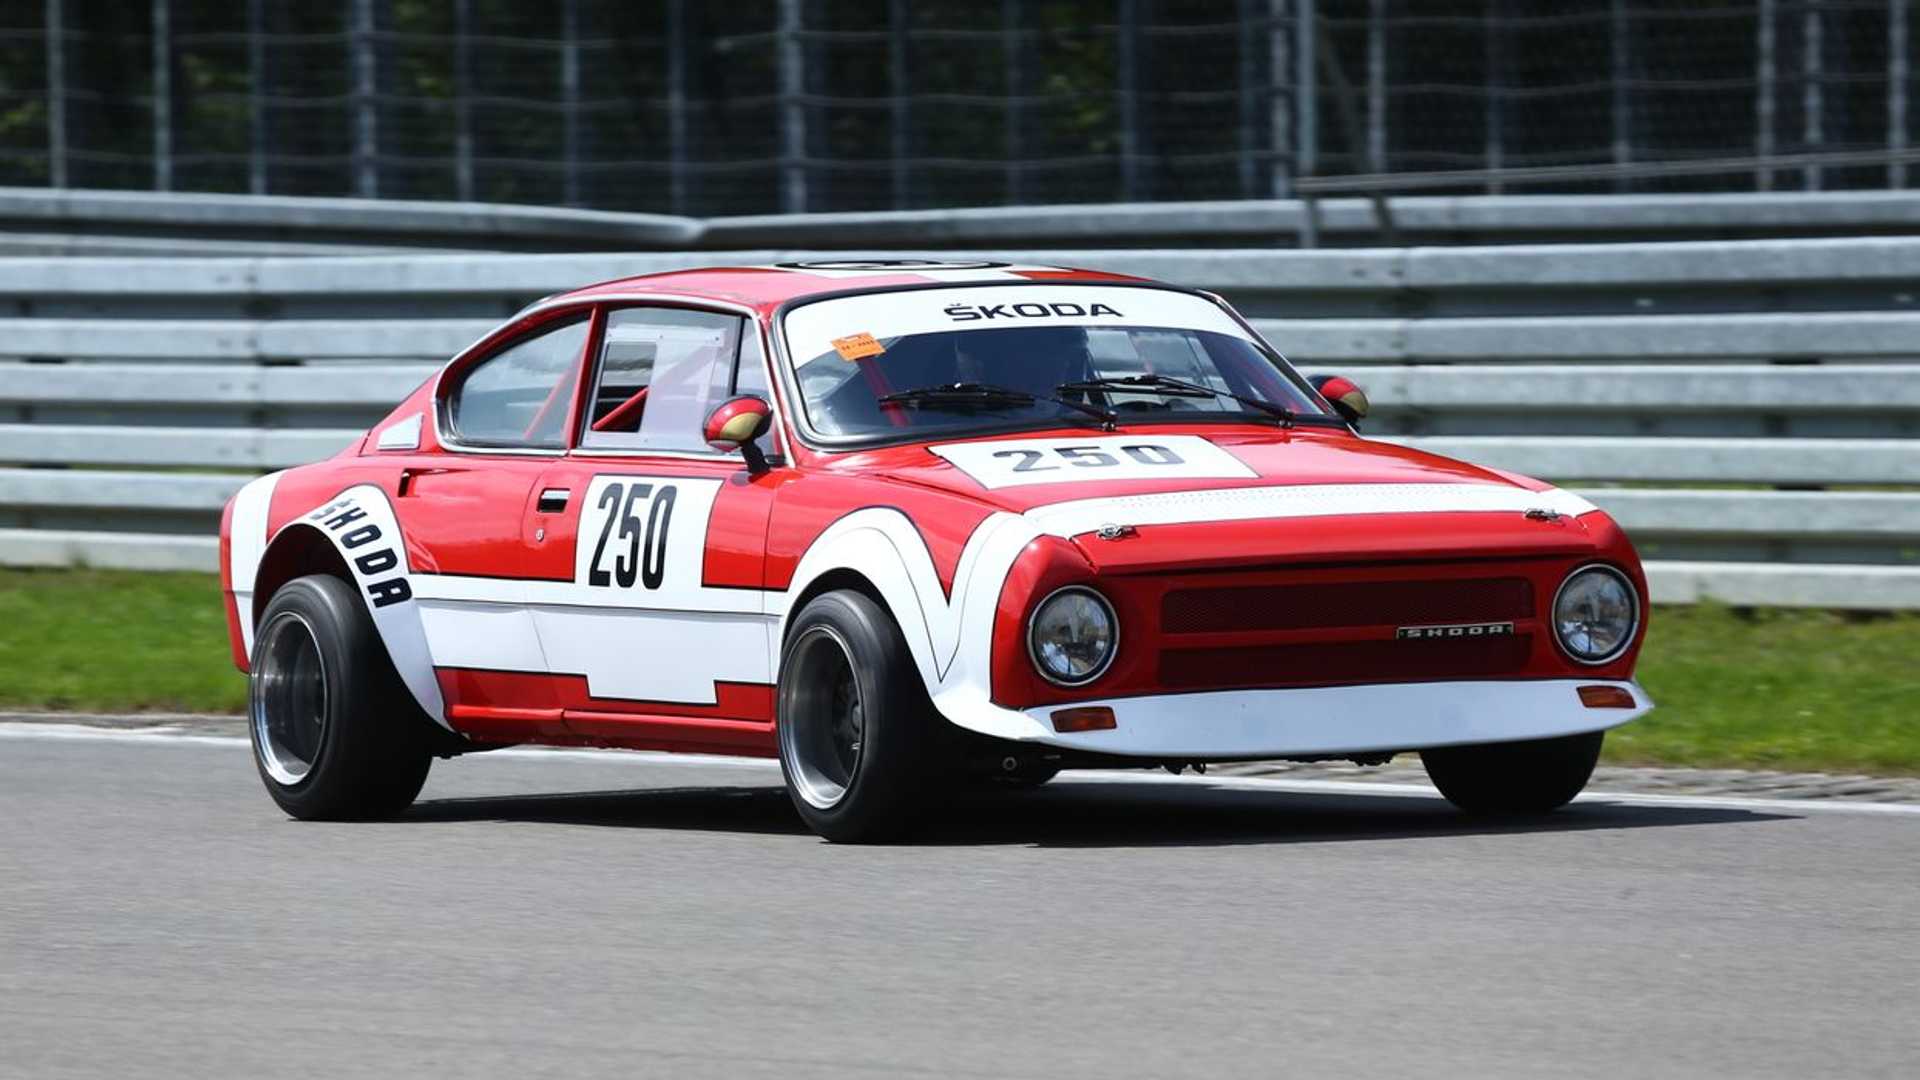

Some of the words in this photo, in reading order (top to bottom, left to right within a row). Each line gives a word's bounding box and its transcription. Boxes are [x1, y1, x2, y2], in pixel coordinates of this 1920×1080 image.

[943, 303, 1124, 322] ŠKODA
[992, 445, 1186, 471] 250
[588, 482, 677, 590] 250
